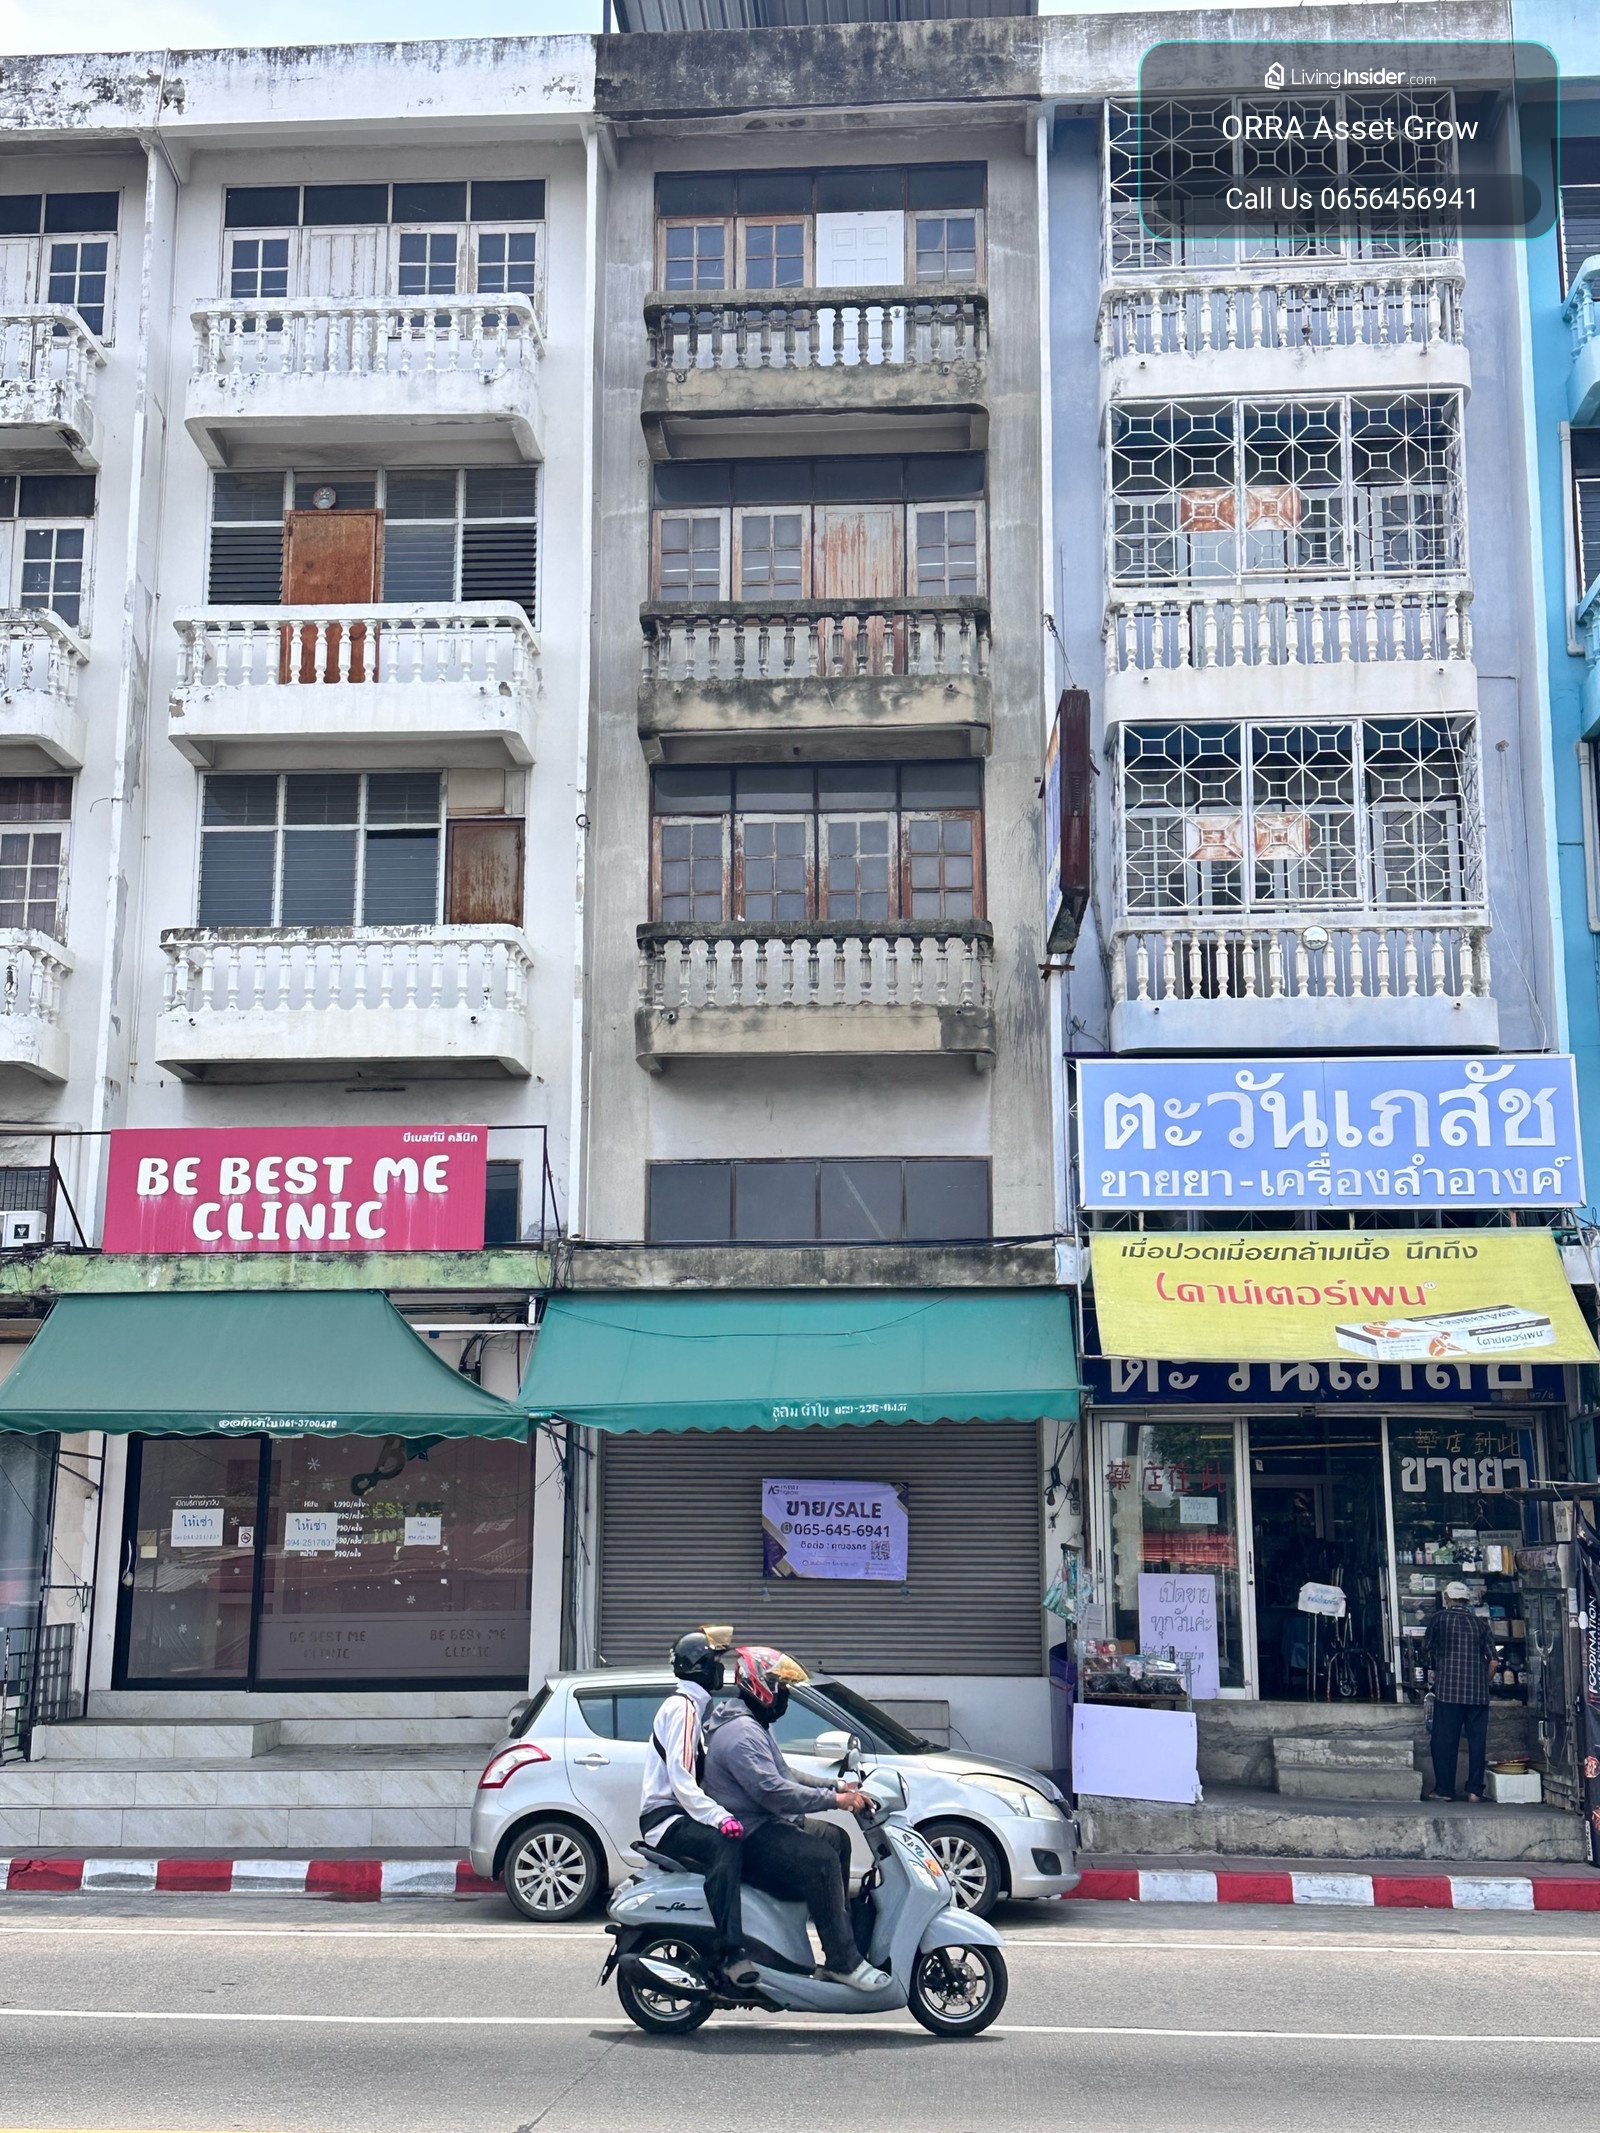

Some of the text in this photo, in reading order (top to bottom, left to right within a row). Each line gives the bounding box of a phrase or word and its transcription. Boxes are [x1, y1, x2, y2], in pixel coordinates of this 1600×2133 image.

[1103, 1060, 1558, 1150] ตะวันเภสัช
[137, 1155, 449, 1196] BE BEST ME
[192, 1201, 387, 1241] CLINIC
[1406, 1240, 1478, 1260] นึกถึง
[1401, 1456, 1529, 1494] ขายยา
[181, 1514, 214, 1527] ให้เช่า
[786, 1500, 882, 1519] ขาย/SALE
[295, 1518, 327, 1531] ให้เช่า
[794, 1523, 890, 1538] 065-645-6941
[1159, 1579, 1210, 1605] เปิดขาย
[1151, 1605, 1213, 1640] ทุกวันค่ะ
